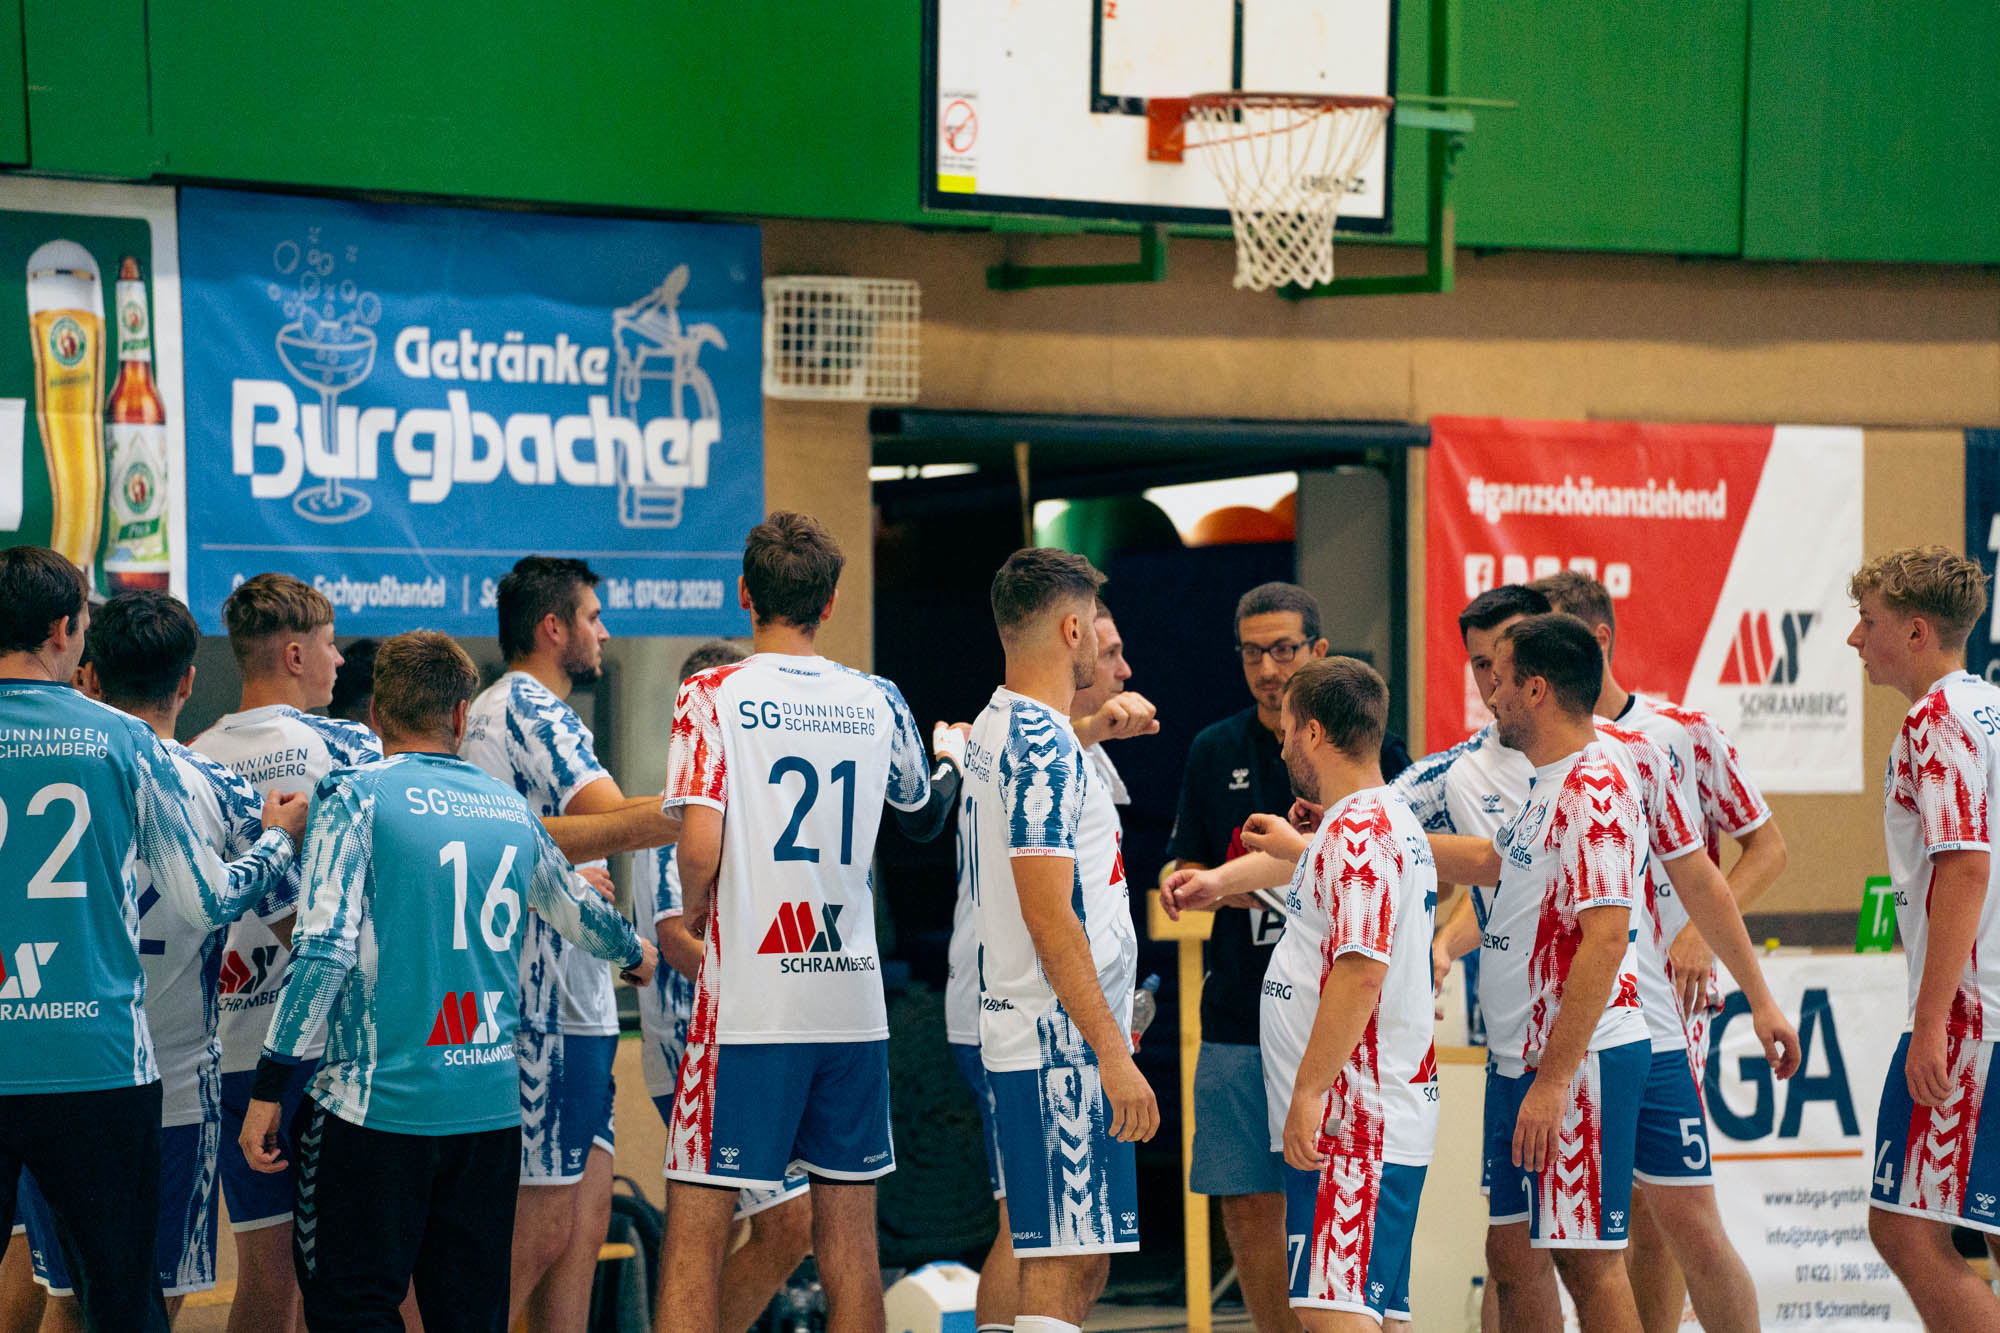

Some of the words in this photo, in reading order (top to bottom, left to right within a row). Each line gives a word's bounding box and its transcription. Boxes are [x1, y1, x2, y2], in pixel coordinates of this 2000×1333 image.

[395, 326, 610, 384] Getränke
[232, 378, 721, 504] Burgbacher
[1467, 476, 1727, 524] #ganzschönanziehend
[739, 700, 781, 729] SG
[782, 702, 875, 720] DUNNINGEN
[1739, 693, 1848, 716] SCHRAMBERG
[784, 717, 876, 736] SCHRAMBERG
[405, 786, 449, 816] SG
[768, 755, 857, 866] 21
[1016, 847, 1057, 856] Dunningen
[440, 841, 521, 952] 16
[780, 956, 875, 973] SCHRAMBERG
[1679, 1117, 1706, 1170] 5
[1873, 1140, 1895, 1196] 4
[1970, 1206, 1996, 1218] hummel
[1288, 1234, 1306, 1290] 7
[1815, 1300, 1891, 1321] Schramberg
